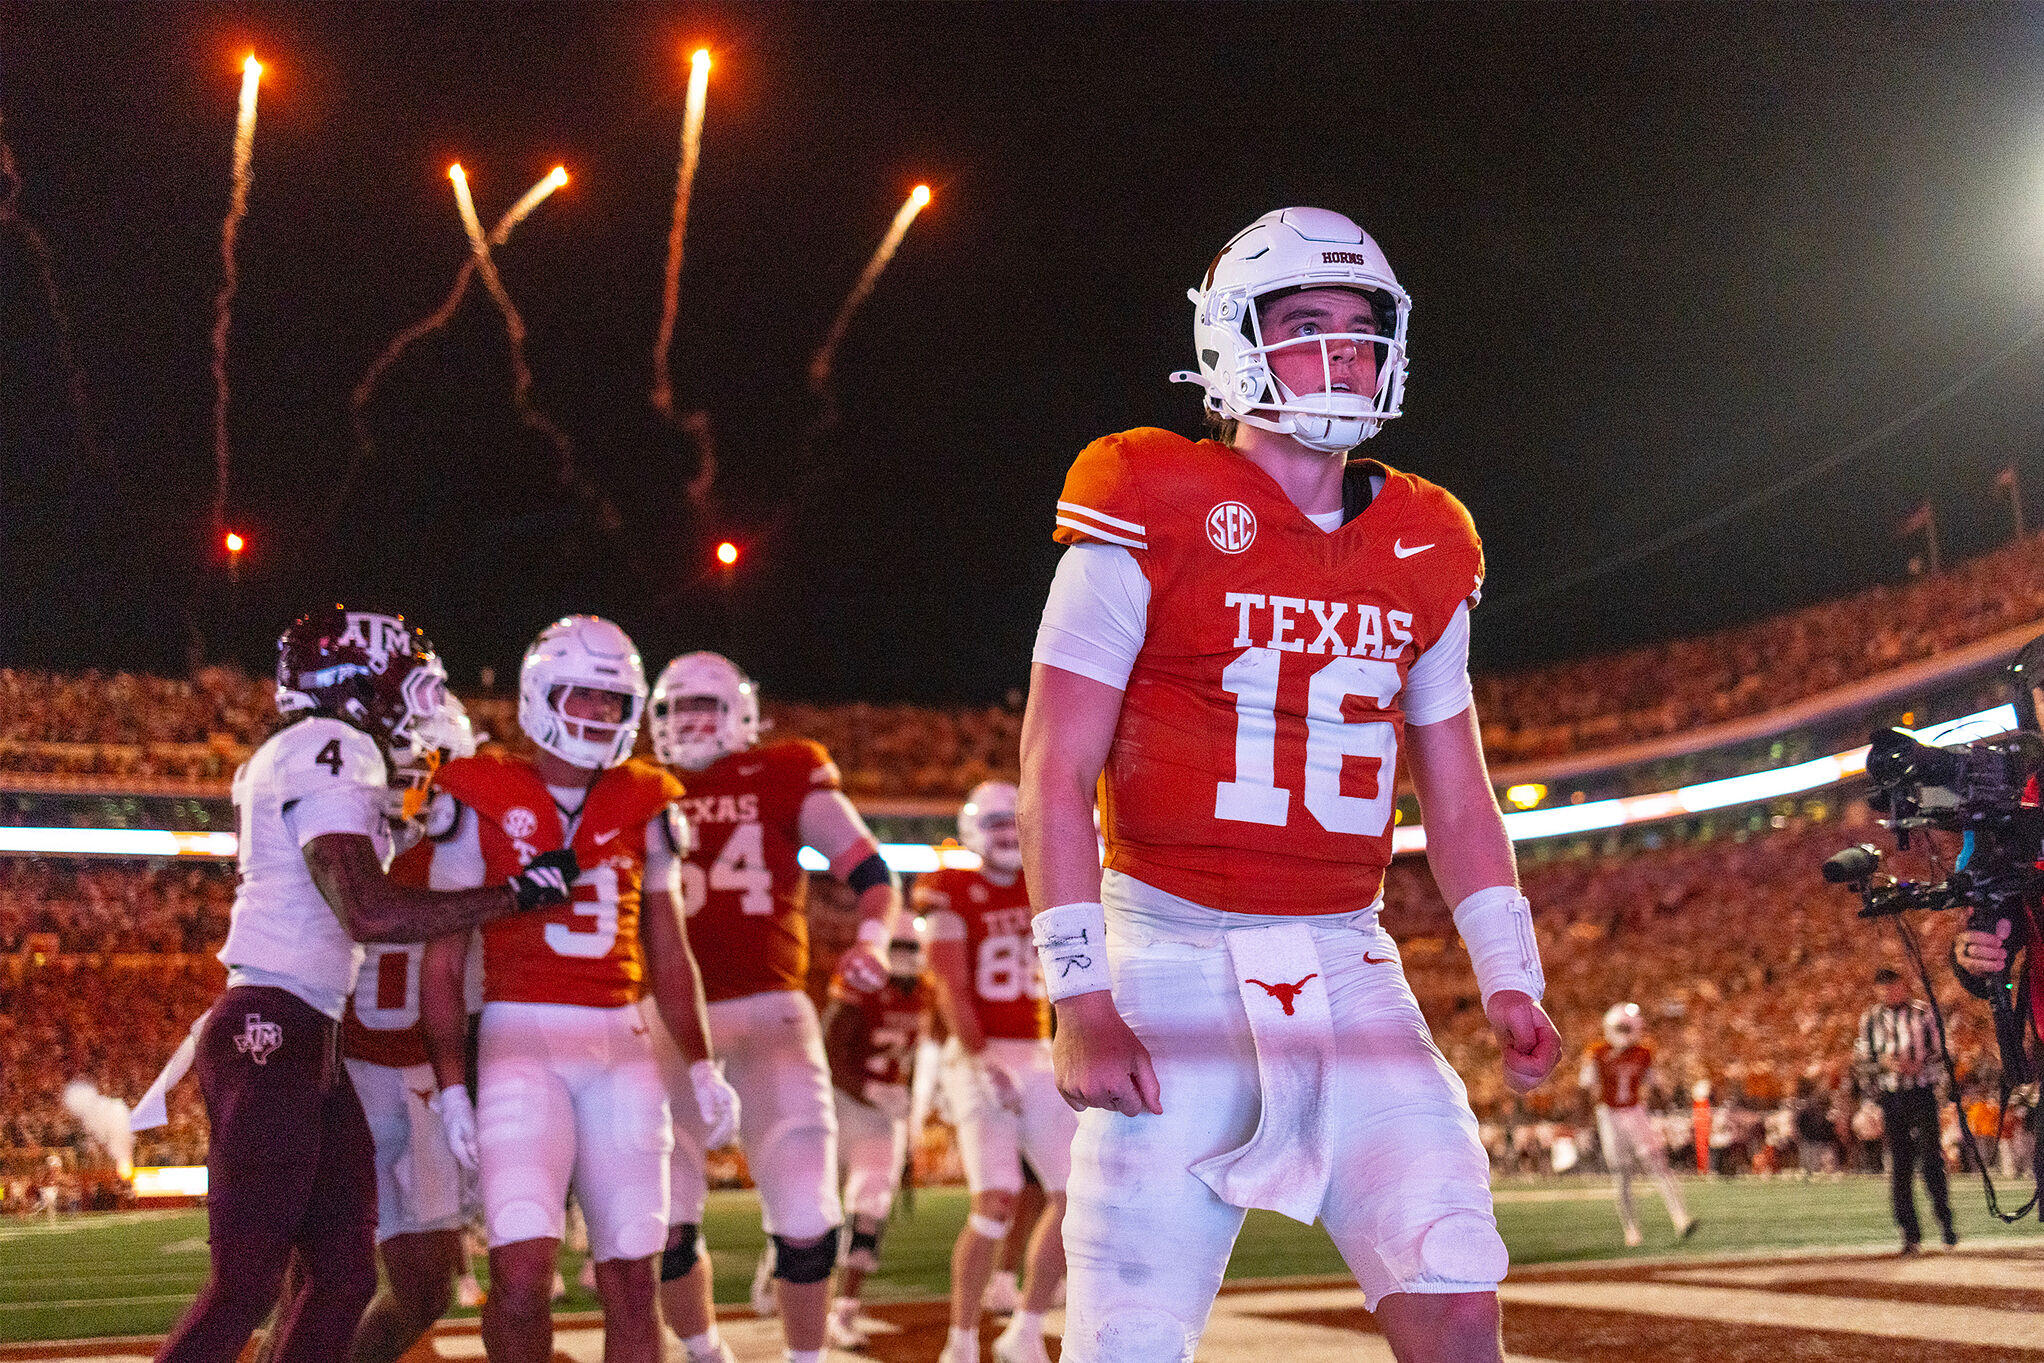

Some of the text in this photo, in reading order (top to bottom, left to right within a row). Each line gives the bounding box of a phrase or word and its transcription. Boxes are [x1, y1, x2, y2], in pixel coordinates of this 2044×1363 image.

[1322, 252, 1364, 265] HORNS
[1211, 505, 1252, 549] SEC
[1225, 592, 1412, 659] TEXAS
[315, 739, 343, 775] 4
[1215, 646, 1402, 837] 16
[681, 794, 759, 823] XAS
[544, 866, 619, 959] 3
